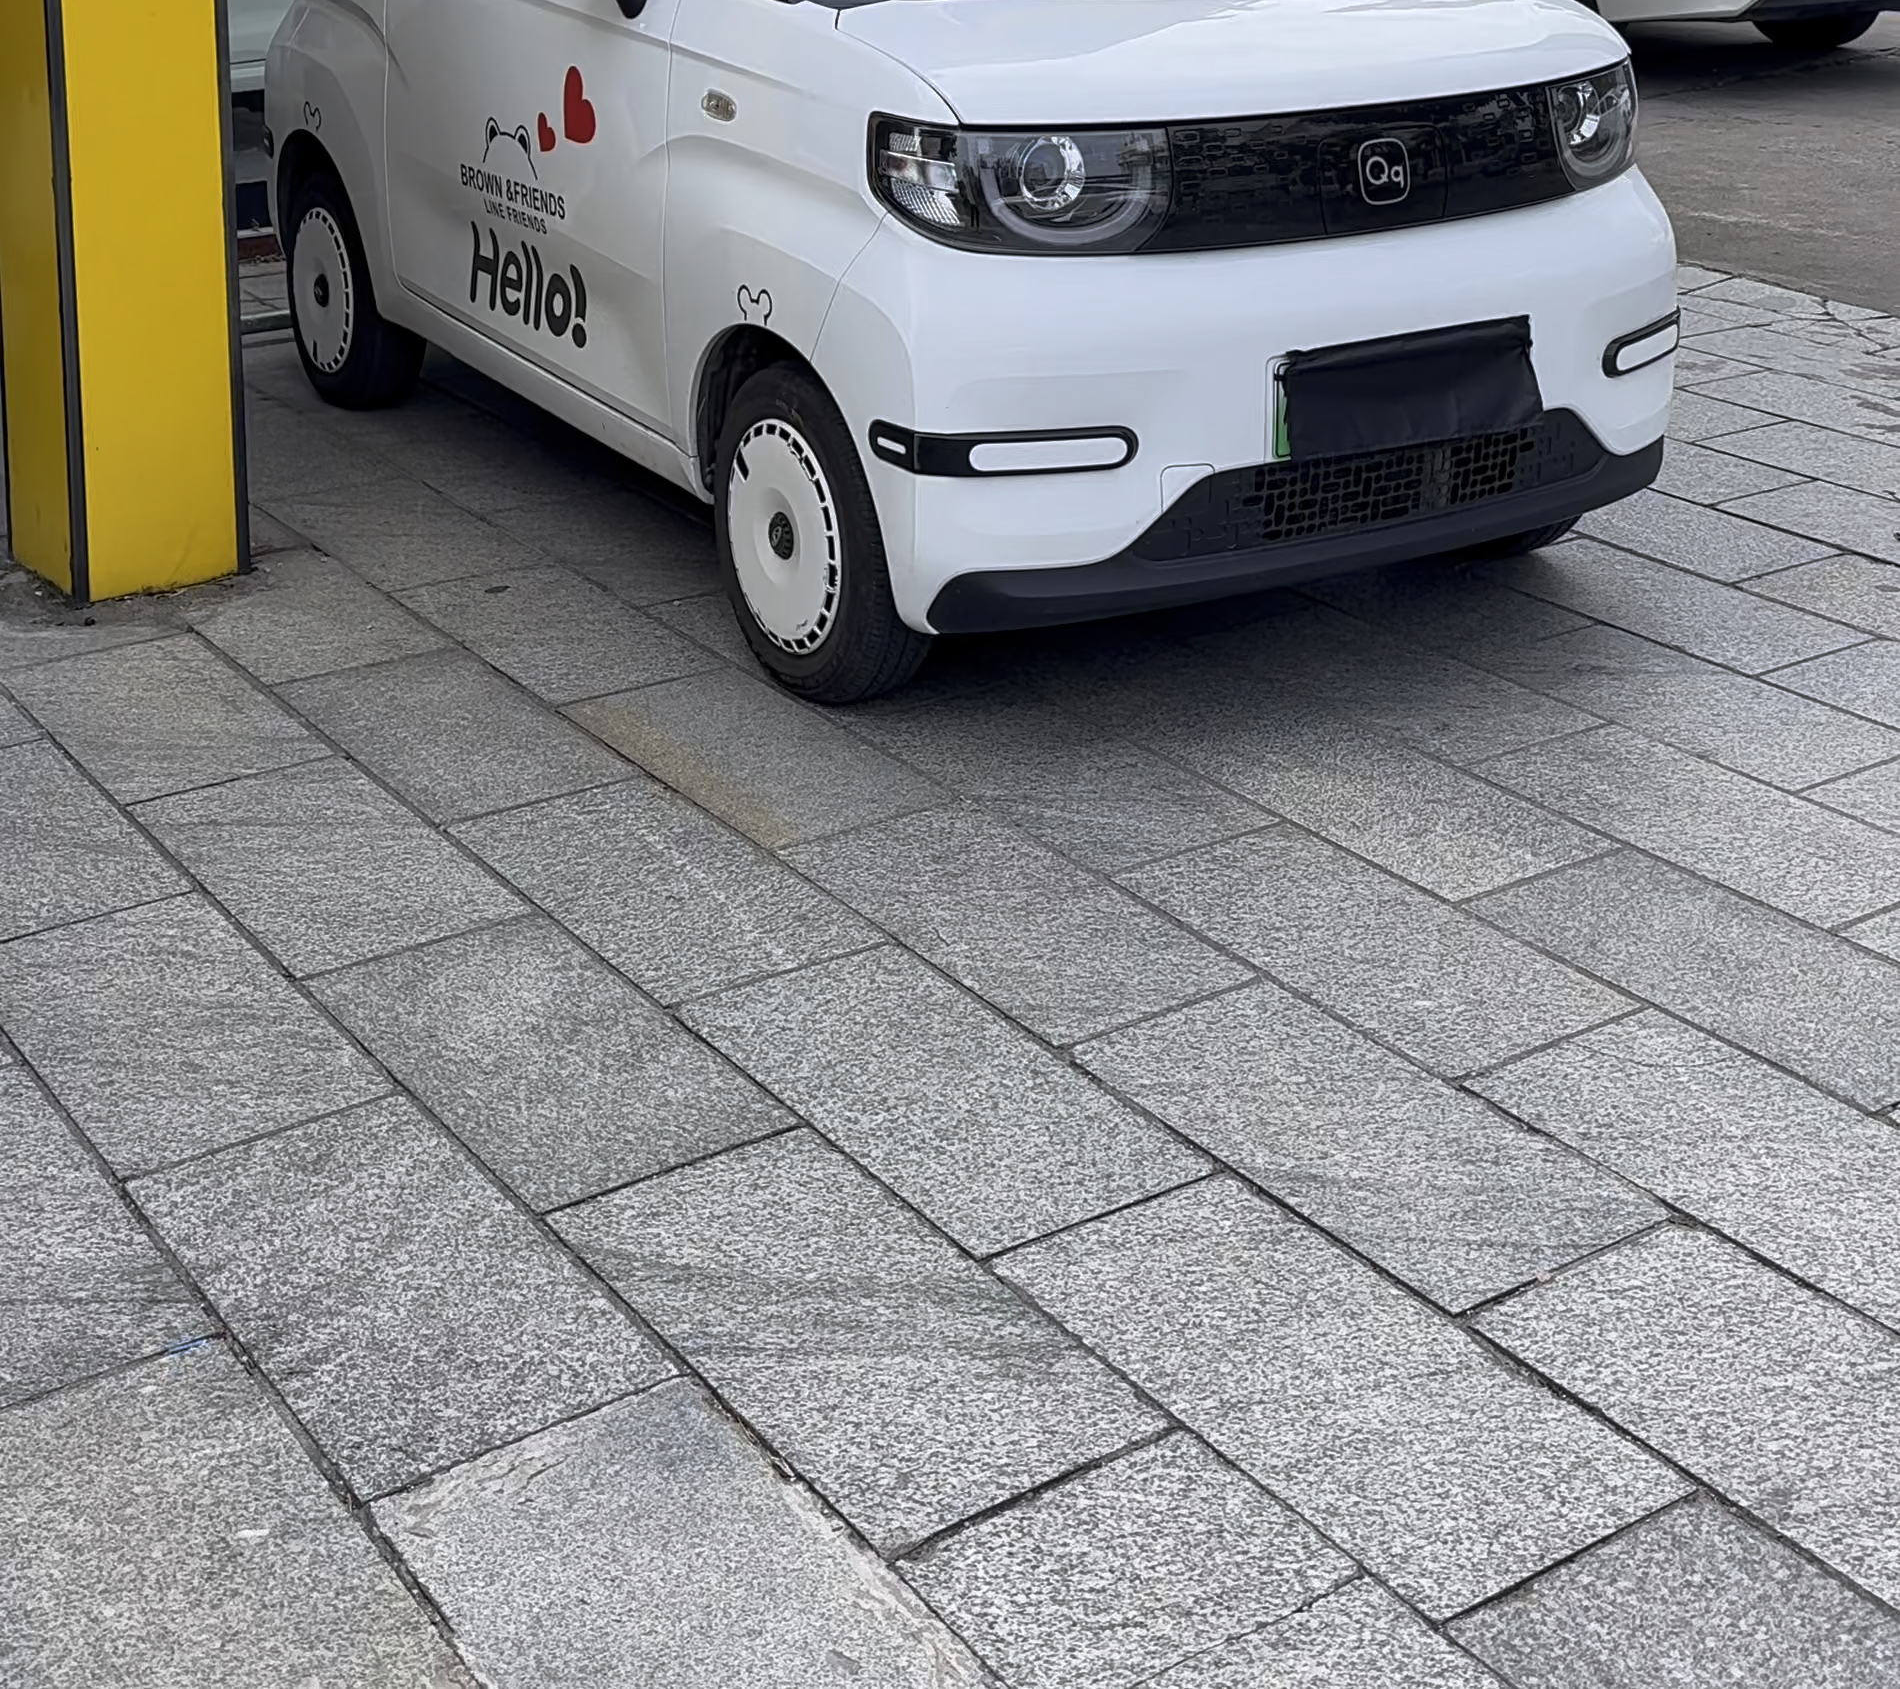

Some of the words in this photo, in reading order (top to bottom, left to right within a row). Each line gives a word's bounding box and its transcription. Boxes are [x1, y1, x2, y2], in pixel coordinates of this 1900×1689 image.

[460, 163, 503, 199] BROWN
[483, 198, 506, 220] LINE
[507, 207, 548, 235] FRIENDS
[469, 220, 588, 349] Hello!
